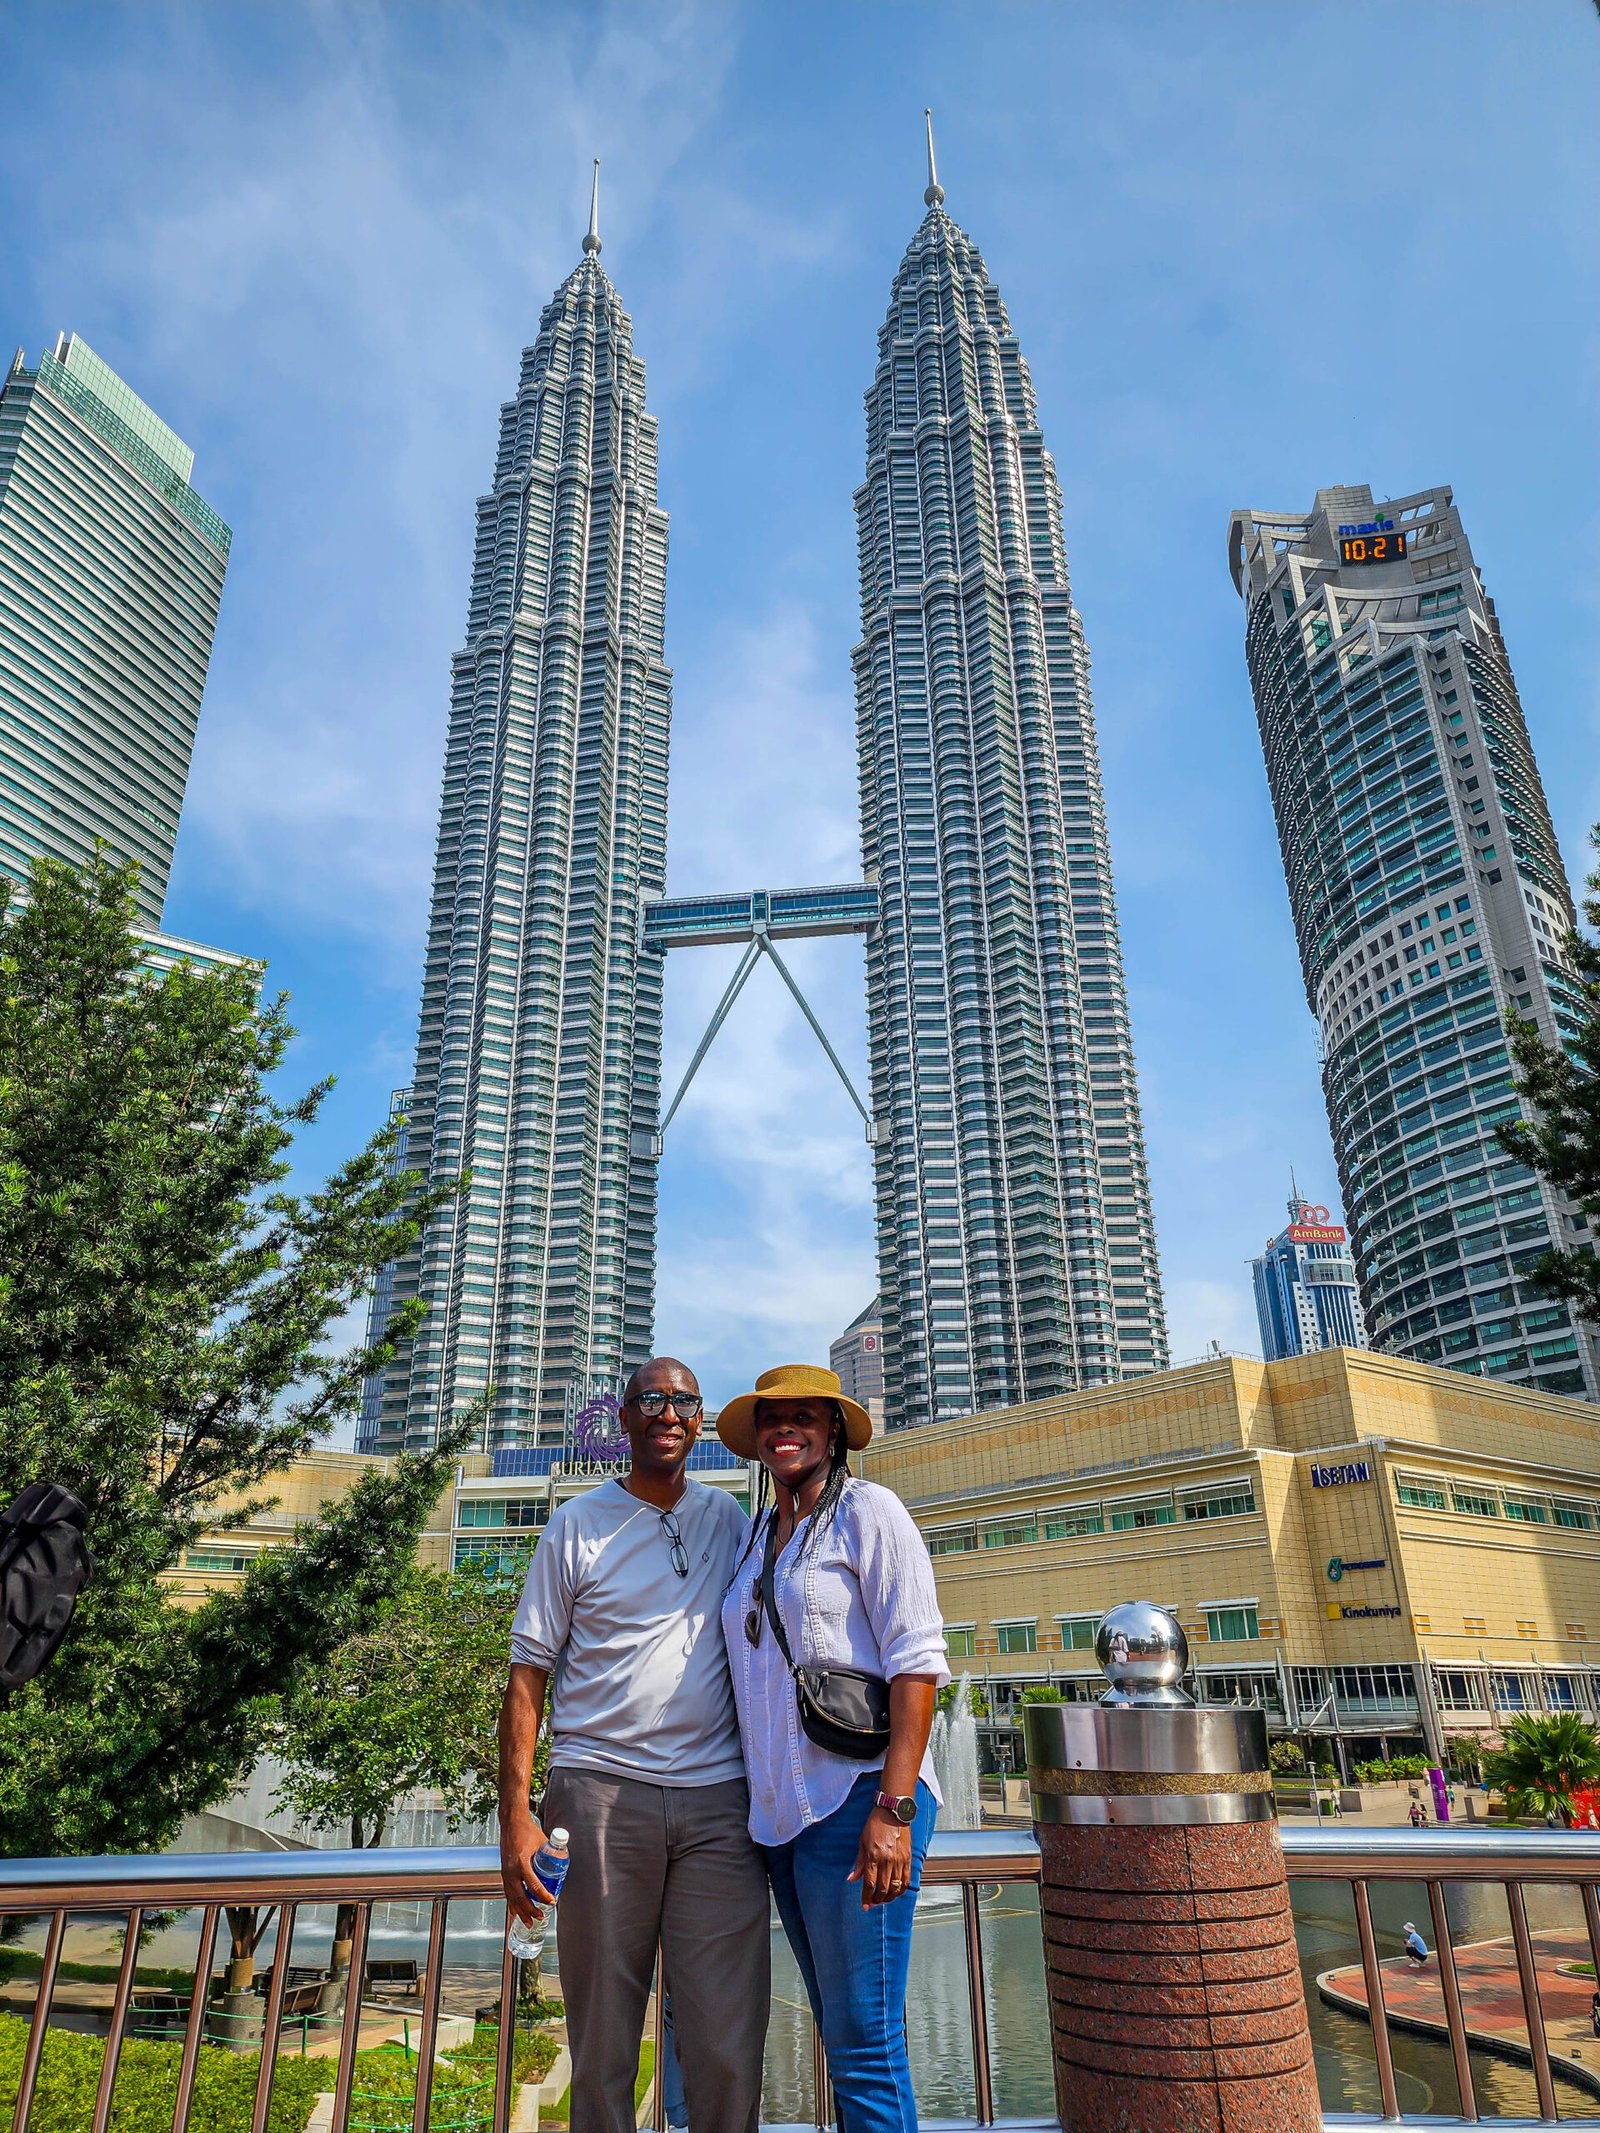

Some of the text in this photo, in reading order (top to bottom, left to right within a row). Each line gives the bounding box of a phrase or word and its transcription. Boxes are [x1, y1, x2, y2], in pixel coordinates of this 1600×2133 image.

[1339, 514, 1394, 535] maxis
[1293, 1229, 1342, 1239] AmBank
[551, 1460, 633, 1476] SURIA KL
[1341, 1605, 1401, 1619] Kinokuniya
